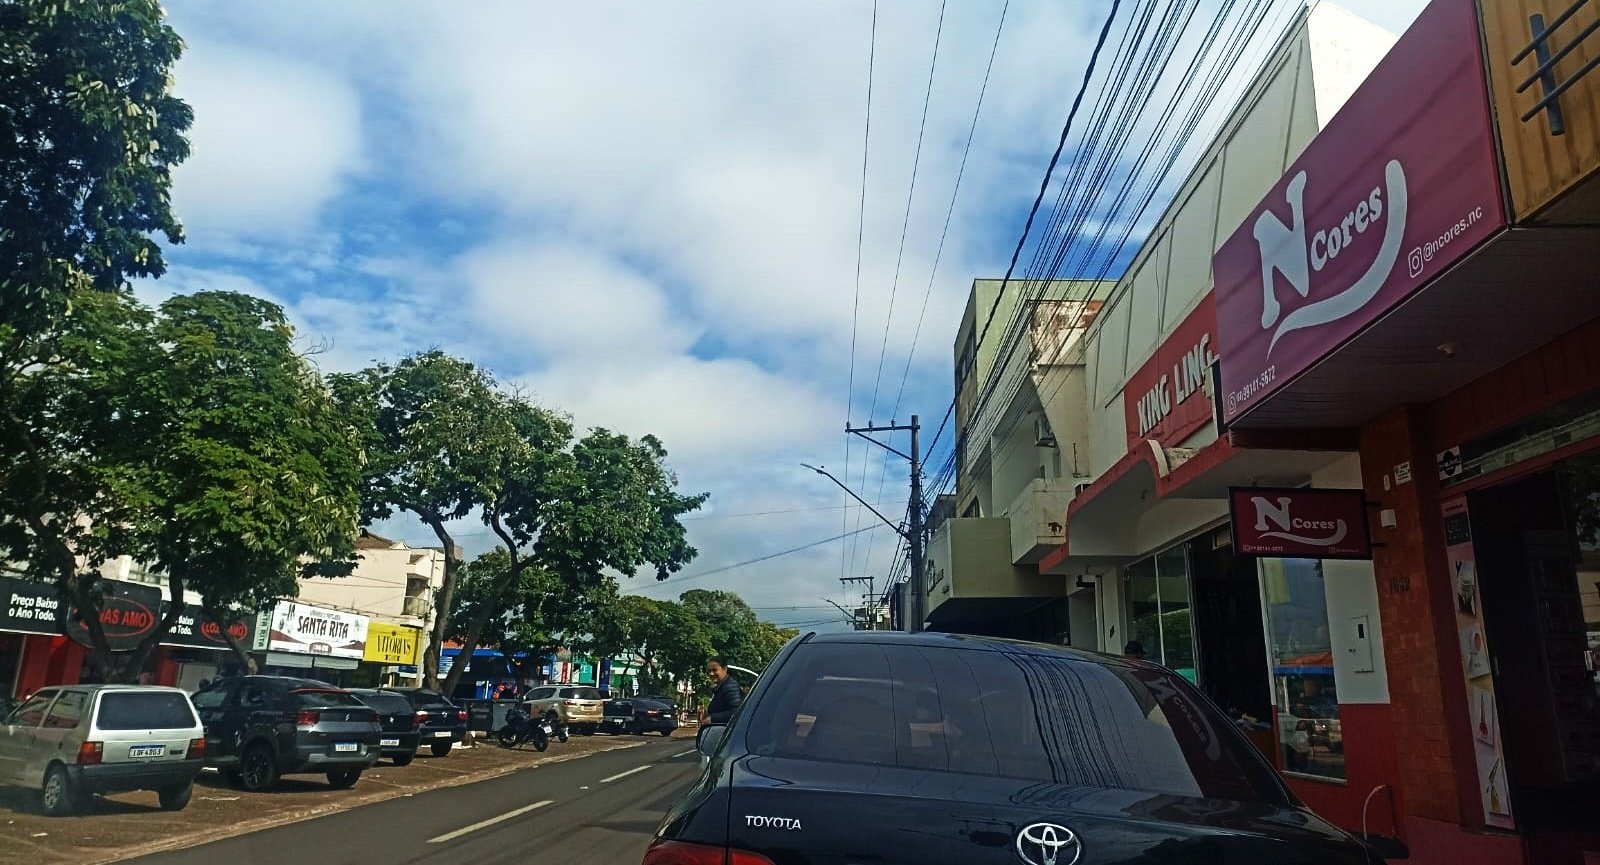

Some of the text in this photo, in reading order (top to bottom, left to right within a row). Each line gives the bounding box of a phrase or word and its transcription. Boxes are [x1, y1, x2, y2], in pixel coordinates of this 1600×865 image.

[1423, 206, 1482, 262] @ncores.nc
[10, 593, 58, 609] Preço Baixo
[8, 607, 56, 621] o Ano Todo.
[121, 611, 147, 628] AMO
[297, 615, 327, 636] SANTA
[328, 620, 349, 639] RITA
[745, 815, 802, 830] TOYOTA
